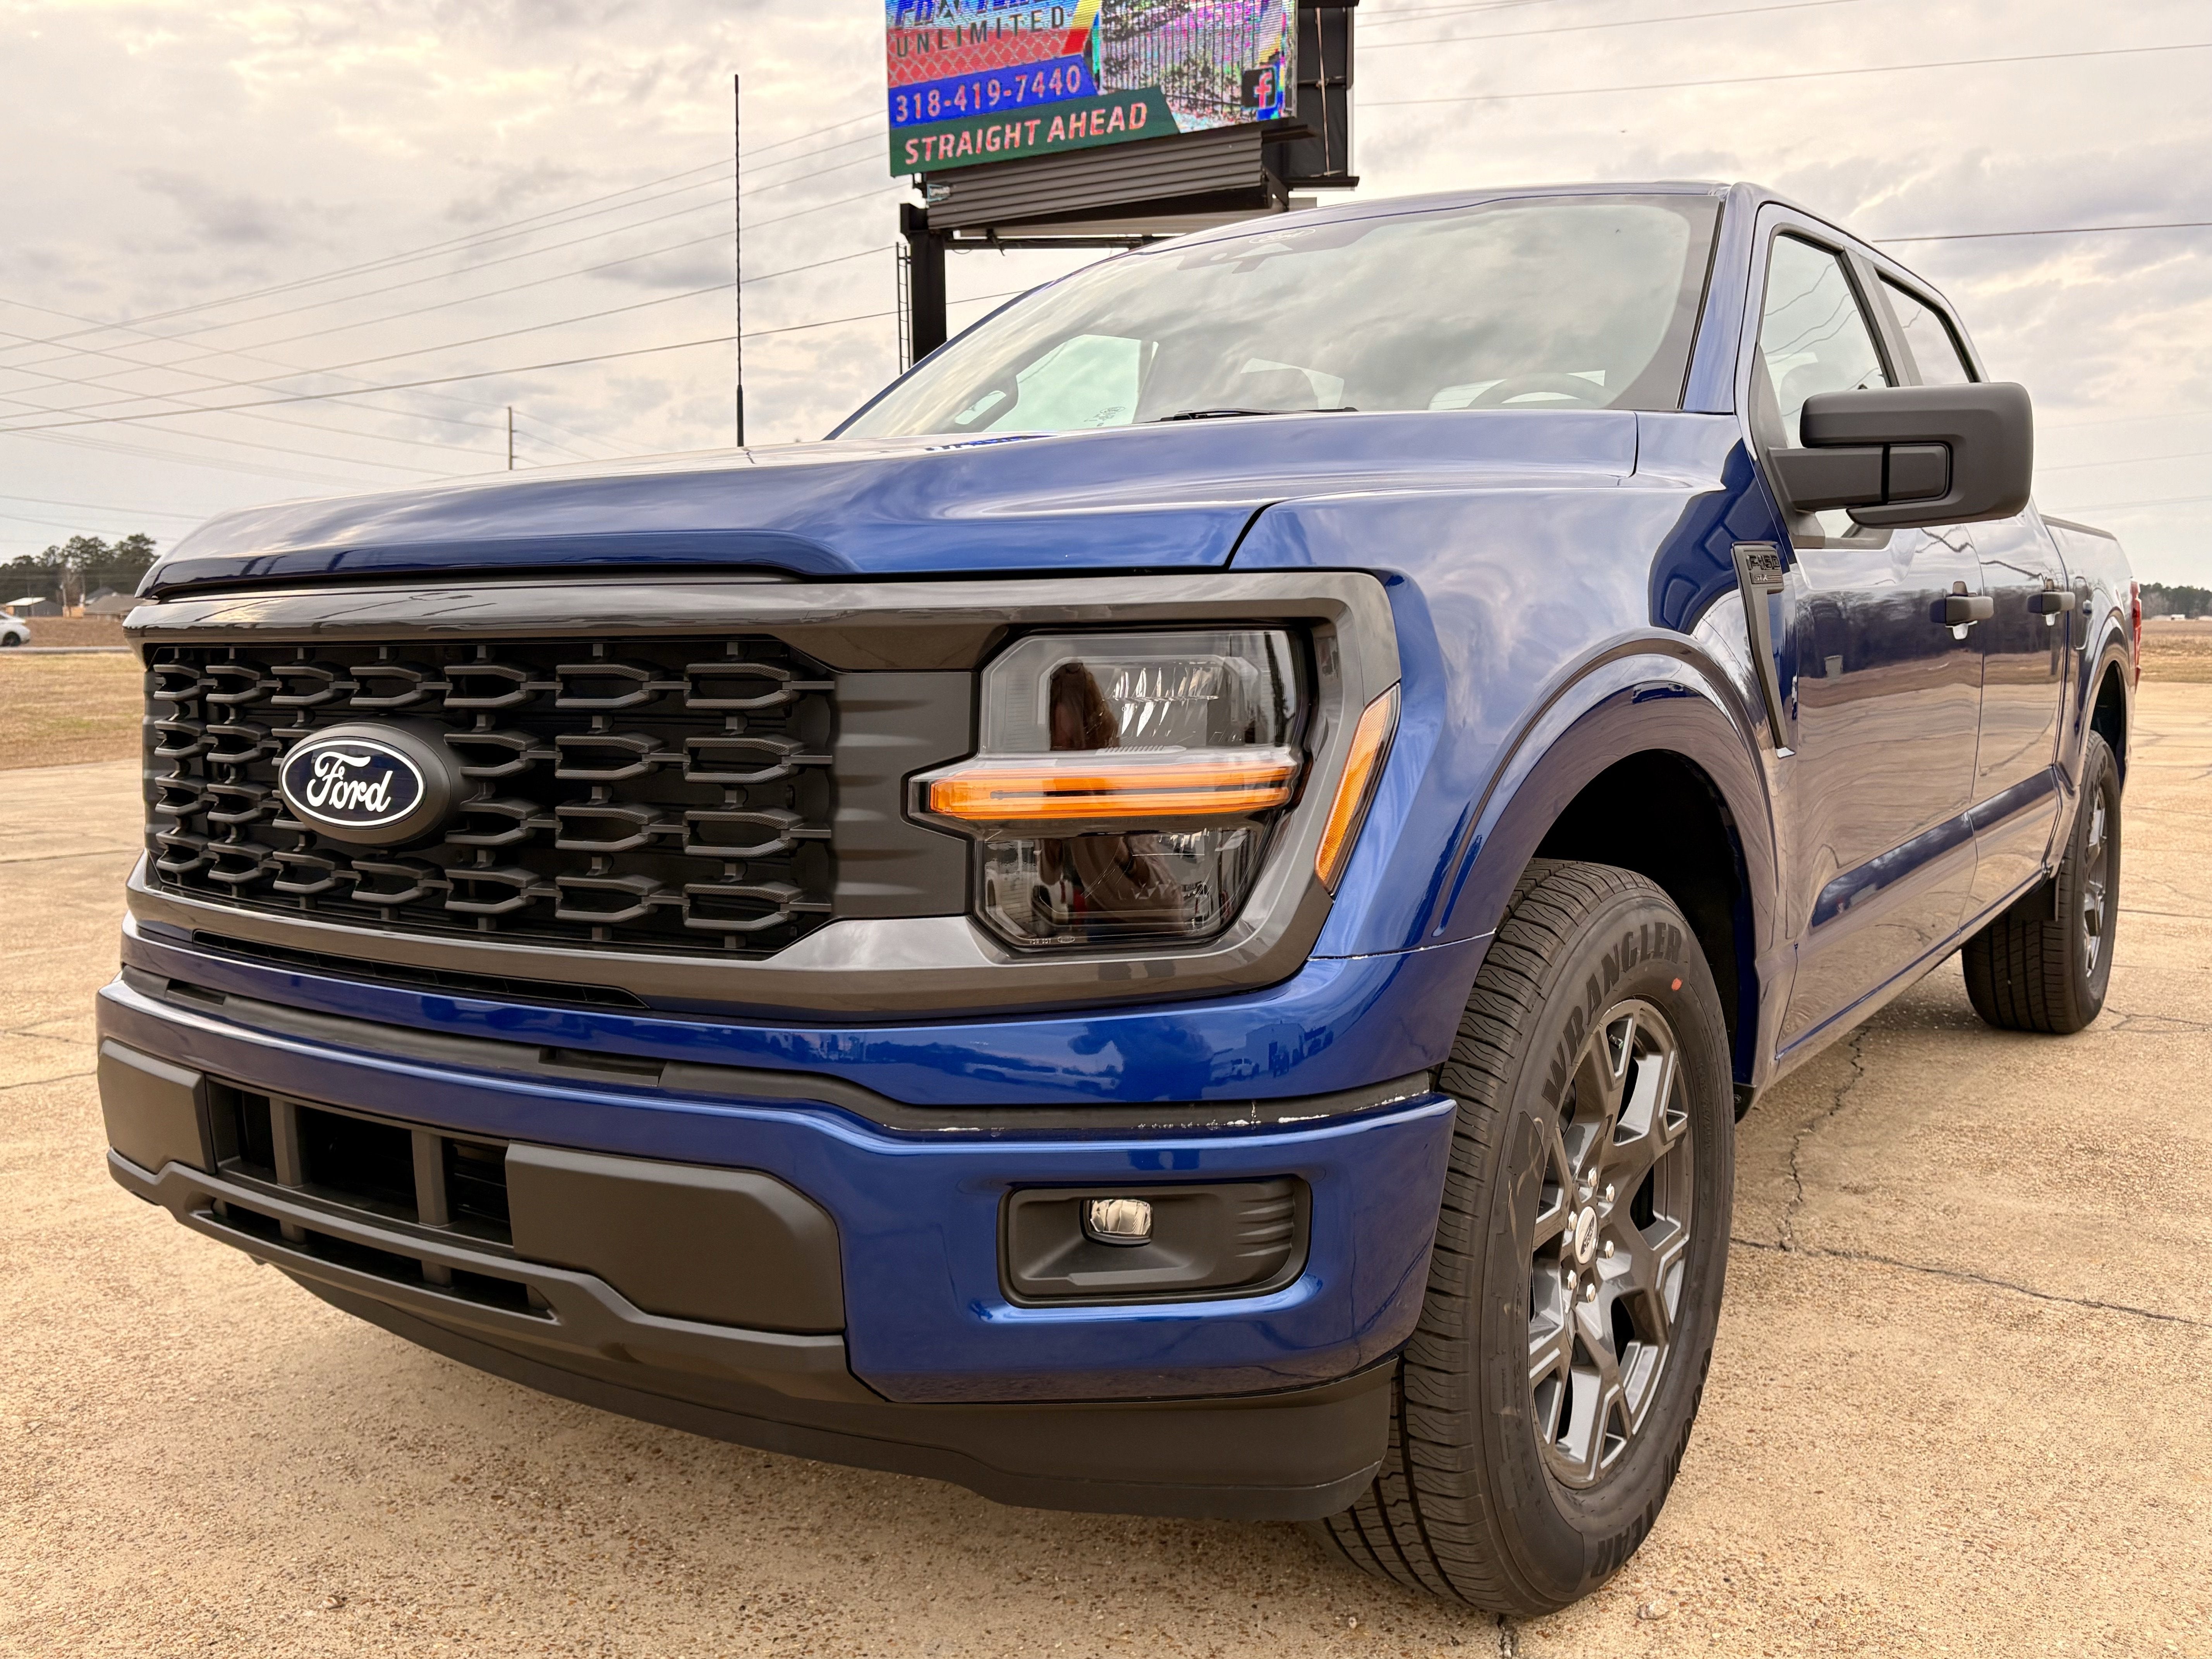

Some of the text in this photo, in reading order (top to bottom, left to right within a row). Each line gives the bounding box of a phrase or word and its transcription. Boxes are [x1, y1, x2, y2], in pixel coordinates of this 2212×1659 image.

[896, 6, 1063, 57] UNLIMITED
[896, 65, 1081, 122] 318-419-7440
[905, 102, 1147, 165] STRAIGHT AHEAD
[306, 751, 393, 812] Ford
[1541, 921, 1682, 1111] WRANGLER
